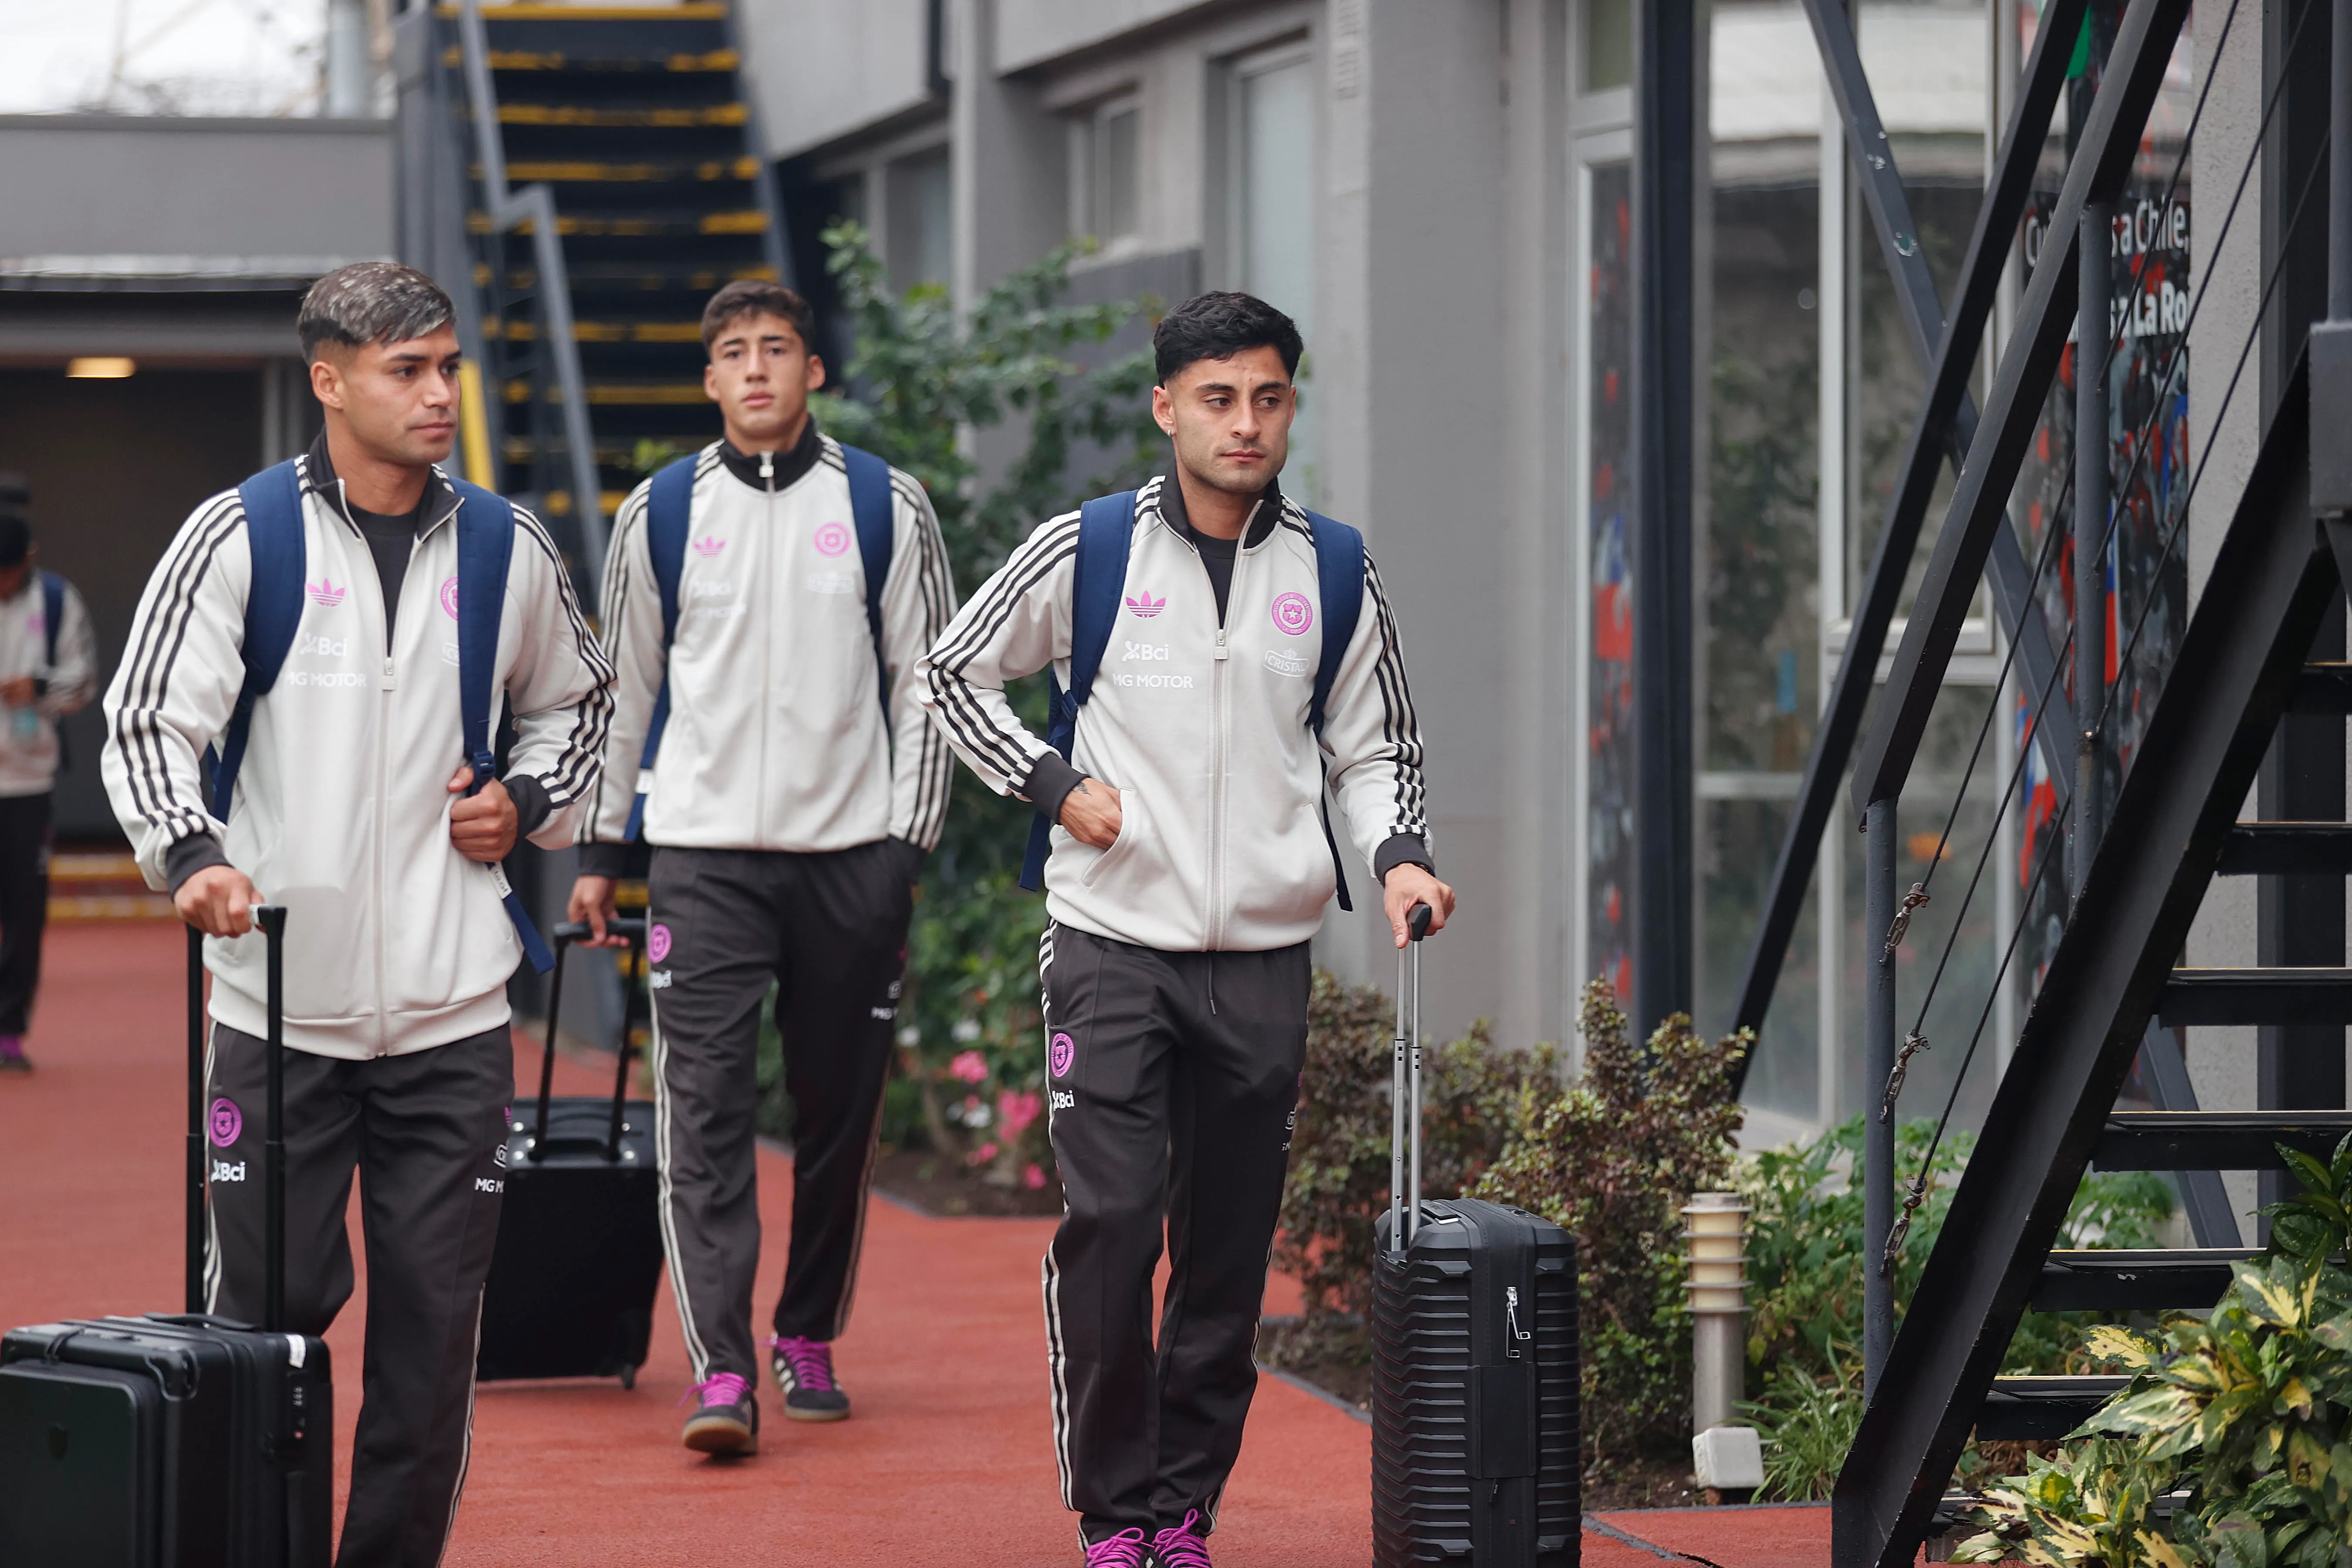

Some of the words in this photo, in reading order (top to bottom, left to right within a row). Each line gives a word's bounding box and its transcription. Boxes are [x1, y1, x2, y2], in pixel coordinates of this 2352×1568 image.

[2135, 194, 2189, 254] Chile,
[2134, 288, 2158, 337] La
[2160, 280, 2189, 335] Ro
[318, 637, 348, 656] Bci
[1141, 644, 1169, 661] Bci
[1267, 655, 1306, 672] CRISTAL
[311, 673, 367, 687] MOTOR
[1113, 673, 1133, 688] MG
[1137, 674, 1194, 689] MOTOR
[1059, 1090, 1075, 1109] Bci
[221, 1161, 245, 1181] Bci
[475, 1178, 496, 1192] MG
